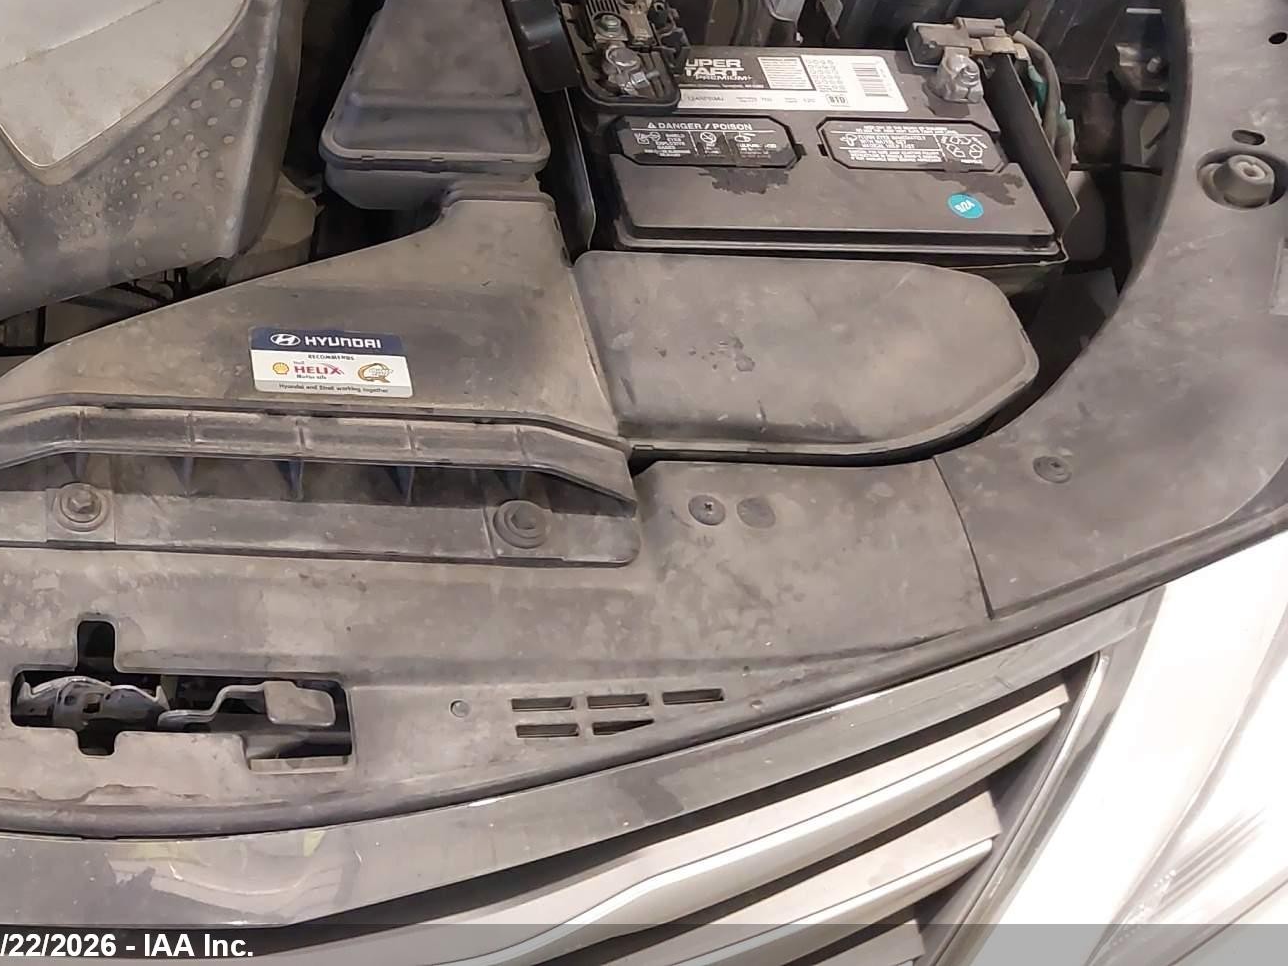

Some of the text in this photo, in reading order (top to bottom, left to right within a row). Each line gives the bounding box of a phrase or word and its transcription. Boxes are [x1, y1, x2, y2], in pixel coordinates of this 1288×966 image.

[685, 58, 742, 68] UPER
[684, 67, 745, 76] TART
[658, 122, 703, 130] DANGER
[712, 123, 753, 131] POISON
[305, 335, 382, 349] HYUNDAI
[294, 365, 343, 375] HELIX
